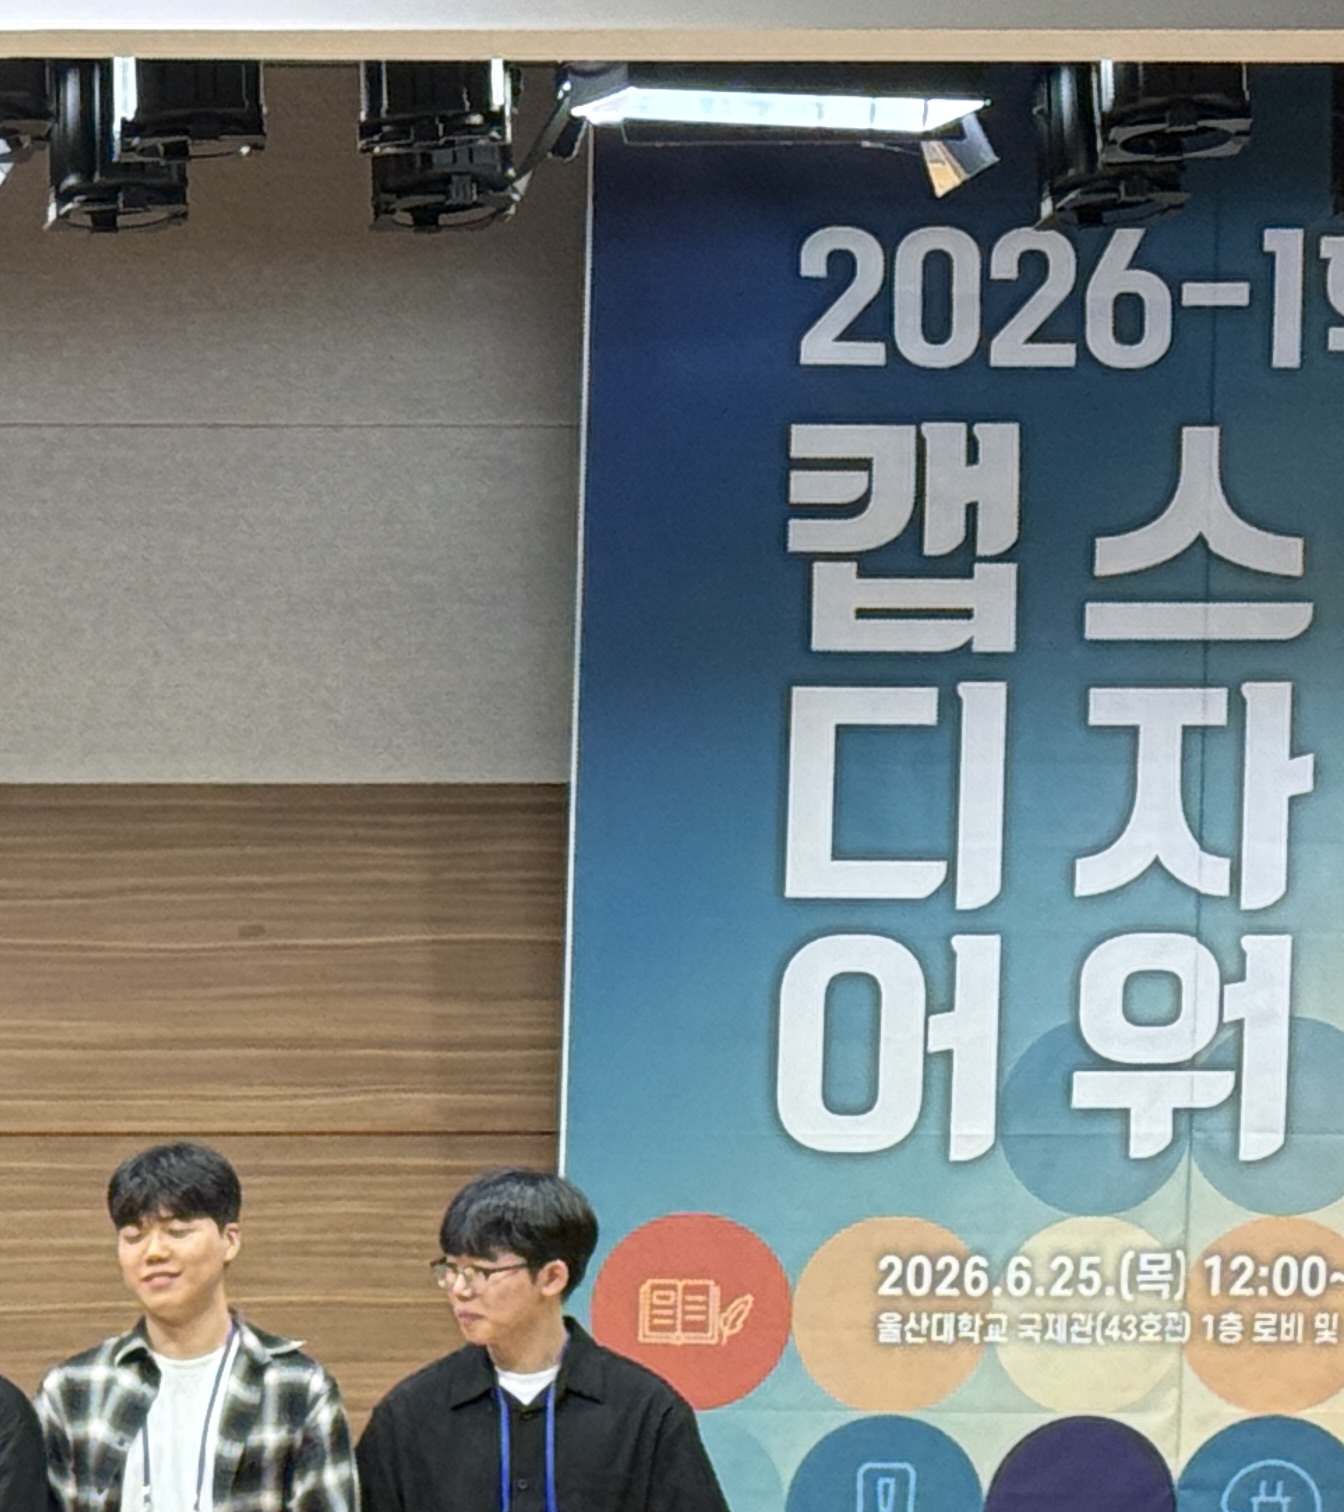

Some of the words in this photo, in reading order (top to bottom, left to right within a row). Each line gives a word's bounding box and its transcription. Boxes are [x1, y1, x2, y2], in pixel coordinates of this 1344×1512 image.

[787, 422, 1313, 653] 캡스
[785, 681, 1314, 911] 디자
[776, 932, 1292, 1161] 어워
[876, 1311, 1008, 1345] 울산대학교
[1201, 1312, 1244, 1344] 1층
[1252, 1312, 1304, 1344] 로비
[1314, 1312, 1339, 1344] 및
[877, 1249, 1186, 1301] 2026.6.25.(목)
